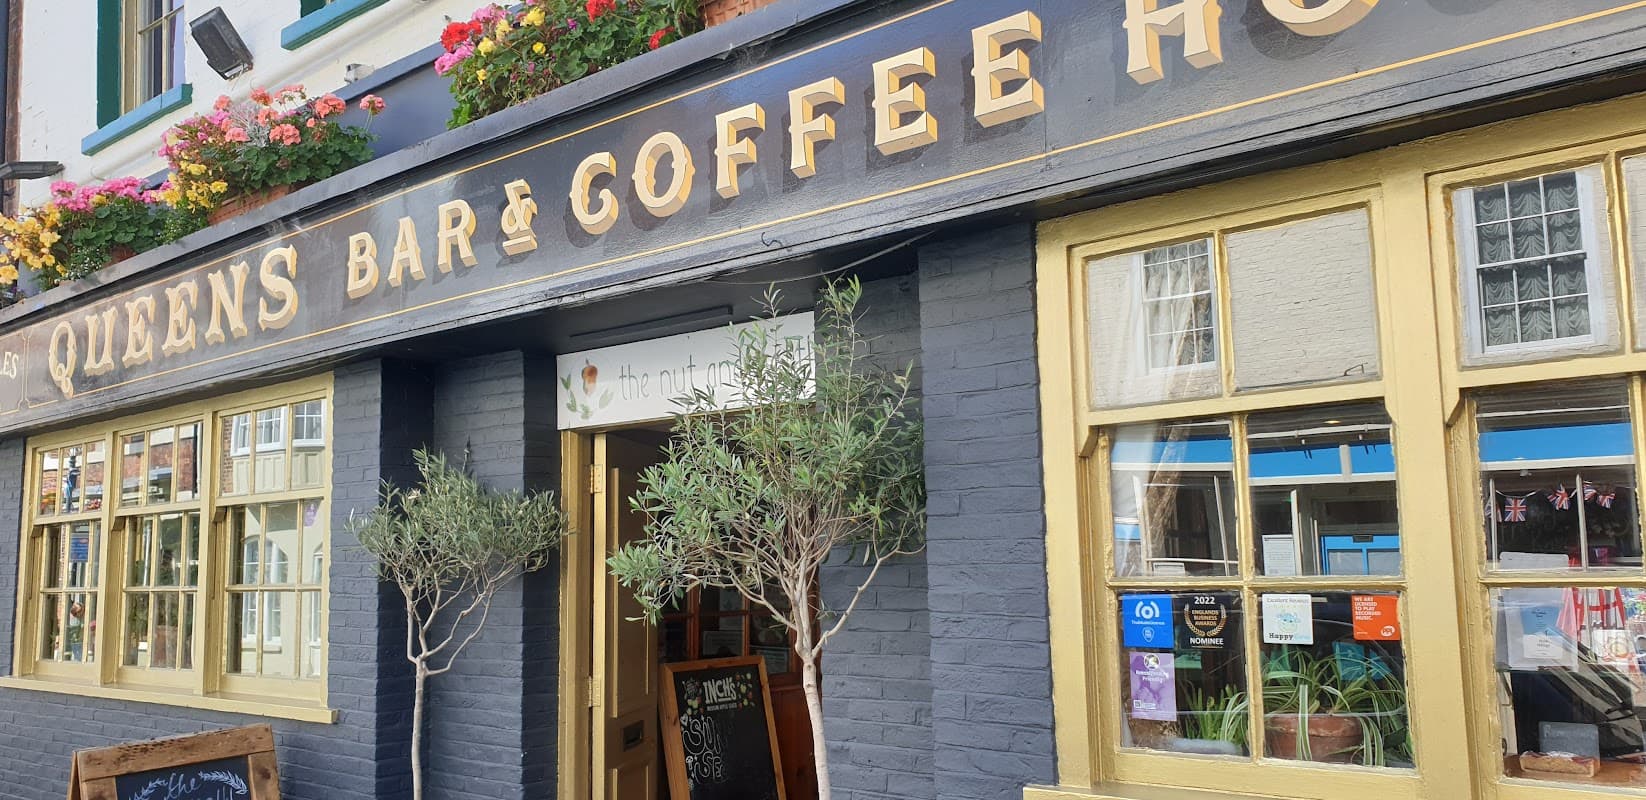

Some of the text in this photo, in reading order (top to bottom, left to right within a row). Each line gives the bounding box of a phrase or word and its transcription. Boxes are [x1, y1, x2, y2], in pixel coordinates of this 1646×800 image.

[48, 243, 299, 399] QUEENS
[347, 199, 478, 299] BAR
[500, 178, 538, 257] &
[569, 10, 1045, 236] COFFEE
[619, 364, 650, 400] the
[660, 354, 697, 396] nut
[1194, 596, 1215, 605] 2022
[1190, 637, 1224, 645] NOMINEE
[166, 772, 200, 800] the
